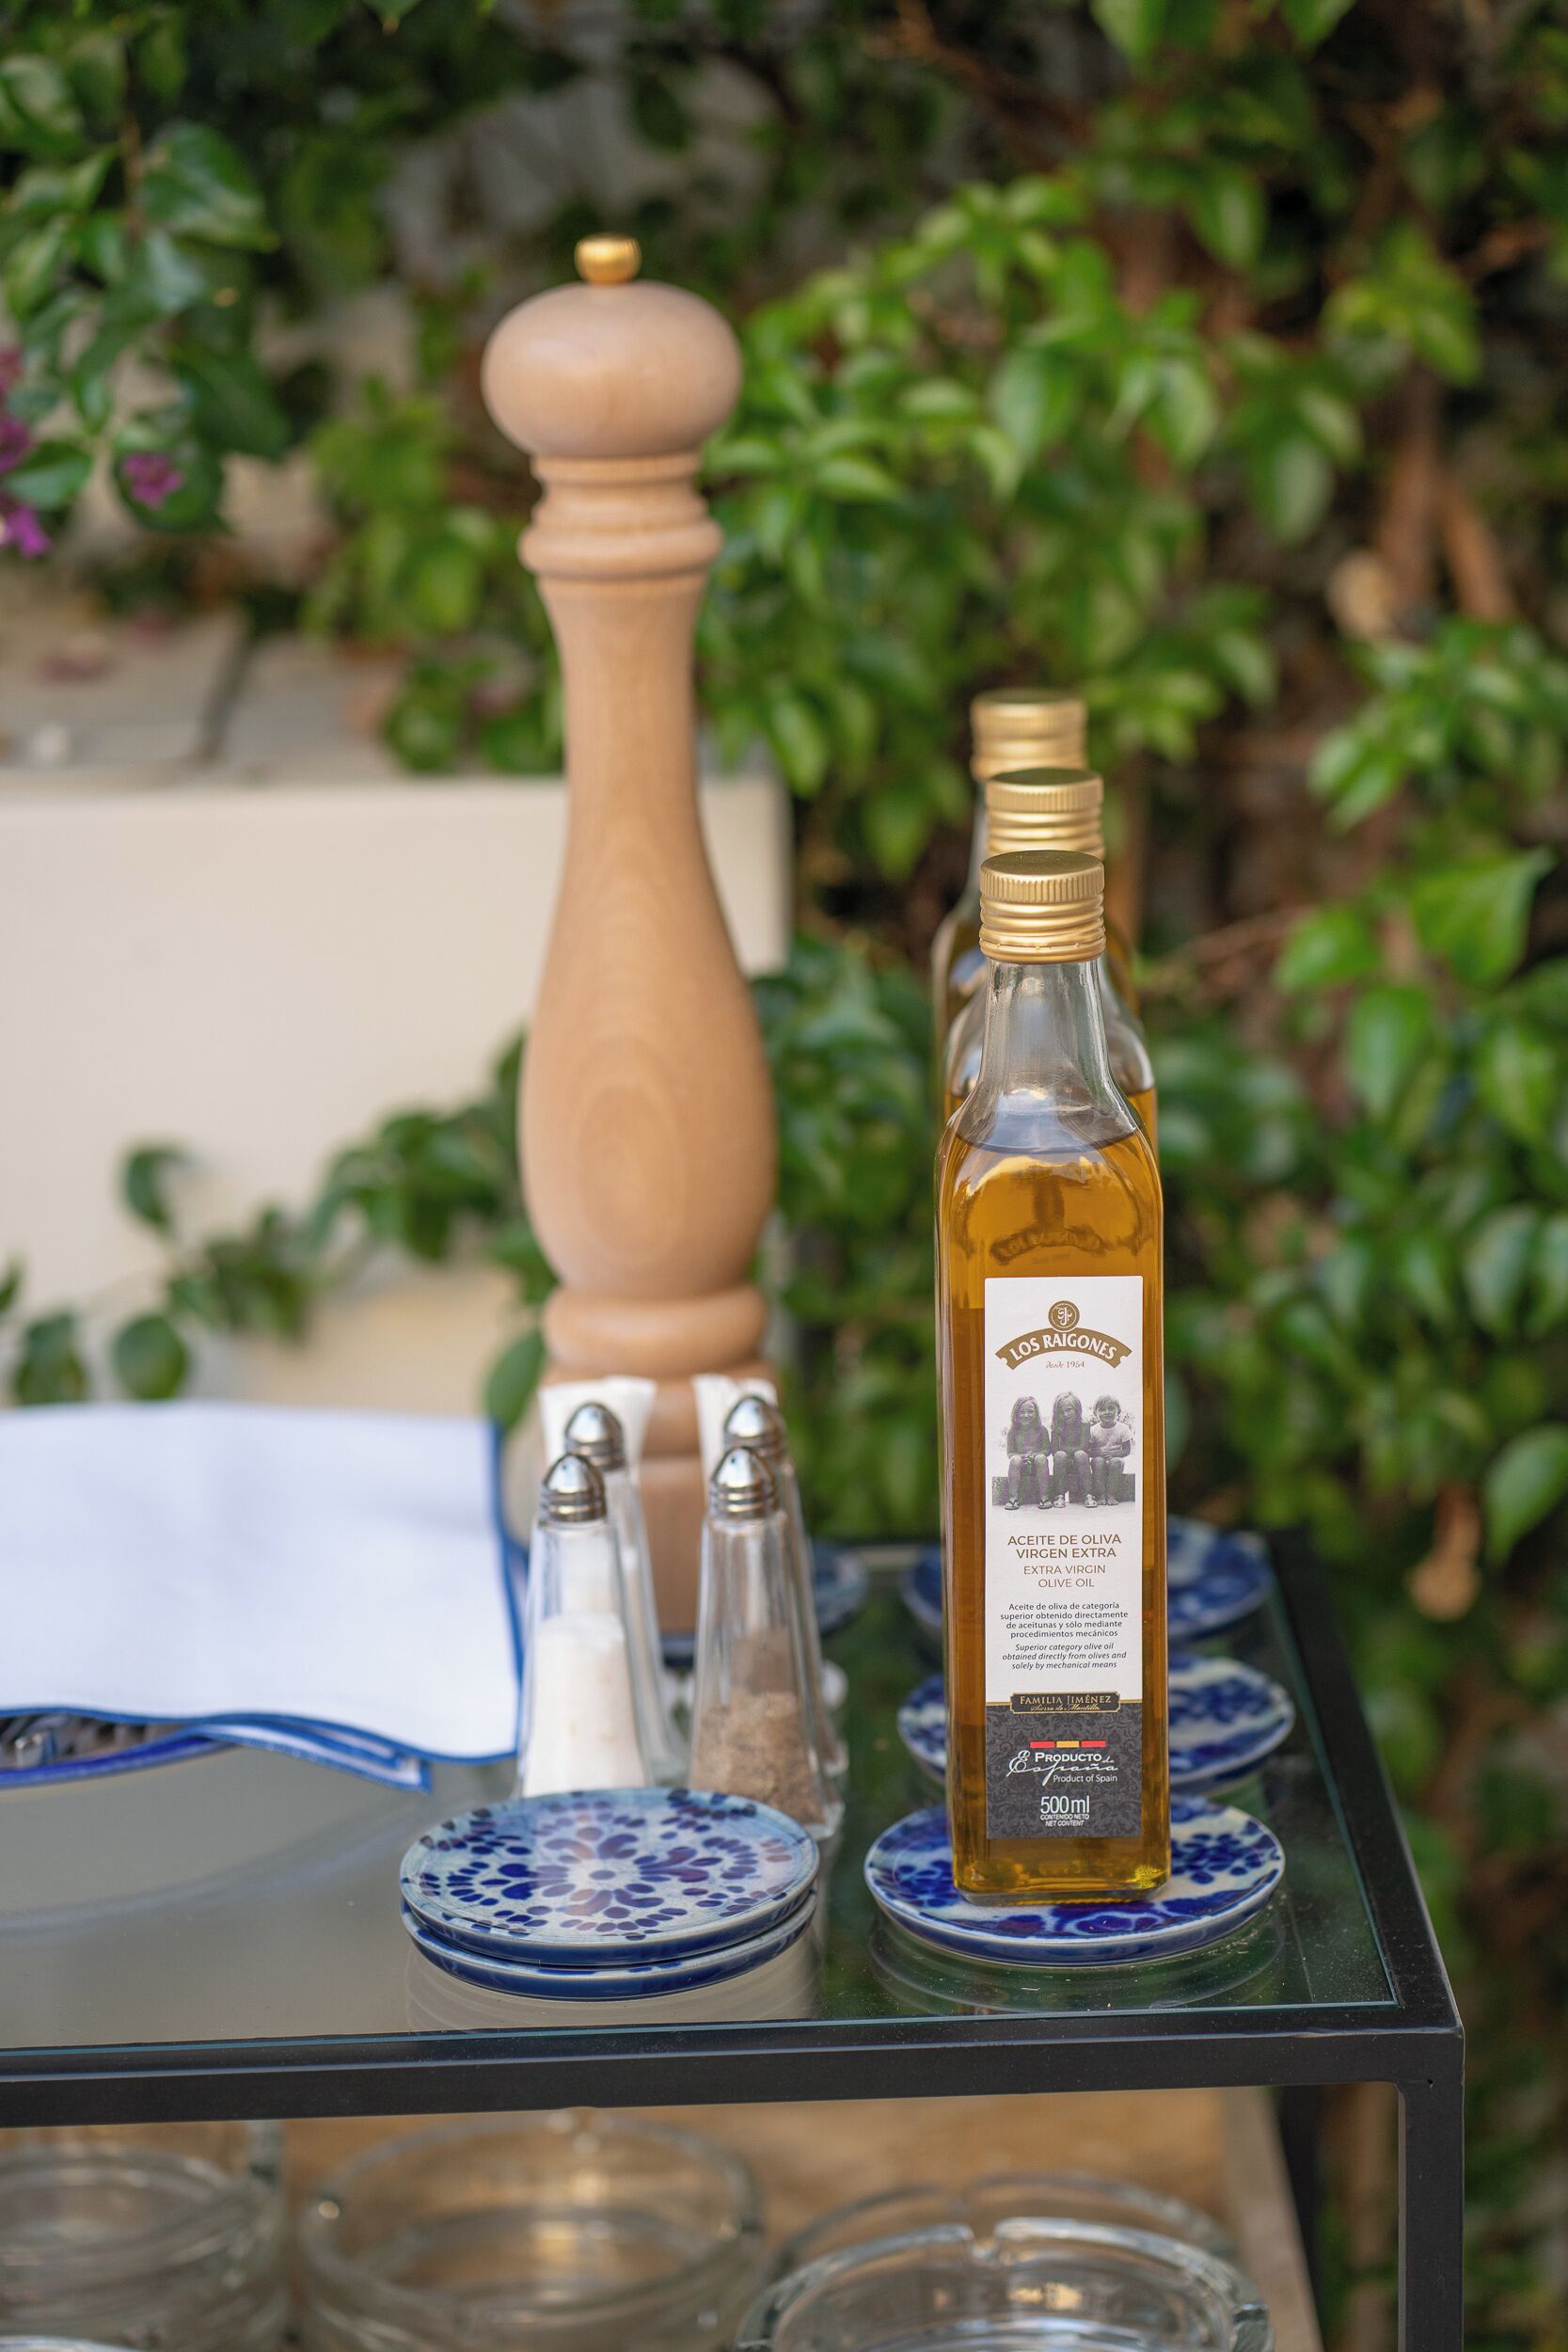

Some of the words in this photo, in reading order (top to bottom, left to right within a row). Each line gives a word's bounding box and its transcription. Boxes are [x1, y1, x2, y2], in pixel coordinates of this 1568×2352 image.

[1009, 1338, 1040, 1360] LOS
[1042, 1333, 1117, 1359] RAIGONES
[1007, 1535, 1055, 1546] ACEITE
[1059, 1535, 1078, 1545] DE
[1082, 1534, 1121, 1545] OLIVA
[1016, 1549, 1068, 1559] VIRGEN
[1072, 1548, 1117, 1558] EXTRA
[1023, 1565, 1062, 1575] EXTRA
[1065, 1565, 1106, 1574] VIRGIN
[1037, 1579, 1072, 1588] OLIVE
[1076, 1578, 1095, 1587] OIL
[1082, 1601, 1119, 1611] categoría
[1000, 1613, 1033, 1621] superior
[1074, 1611, 1129, 1619] directamente
[1011, 1630, 1073, 1639] procedimientos
[1015, 1644, 1047, 1653] Superior
[1049, 1644, 1083, 1652] category
[1038, 1652, 1067, 1661] directly
[1012, 1662, 1034, 1671] solely
[1020, 1695, 1063, 1705] FAMILIA
[1067, 1694, 1112, 1704] JIMÉNEZ
[1006, 1750, 1118, 1787] España
[1096, 1774, 1117, 1783] Spain
[1040, 1796, 1069, 1814] 500
[1071, 1795, 1089, 1813] ml
